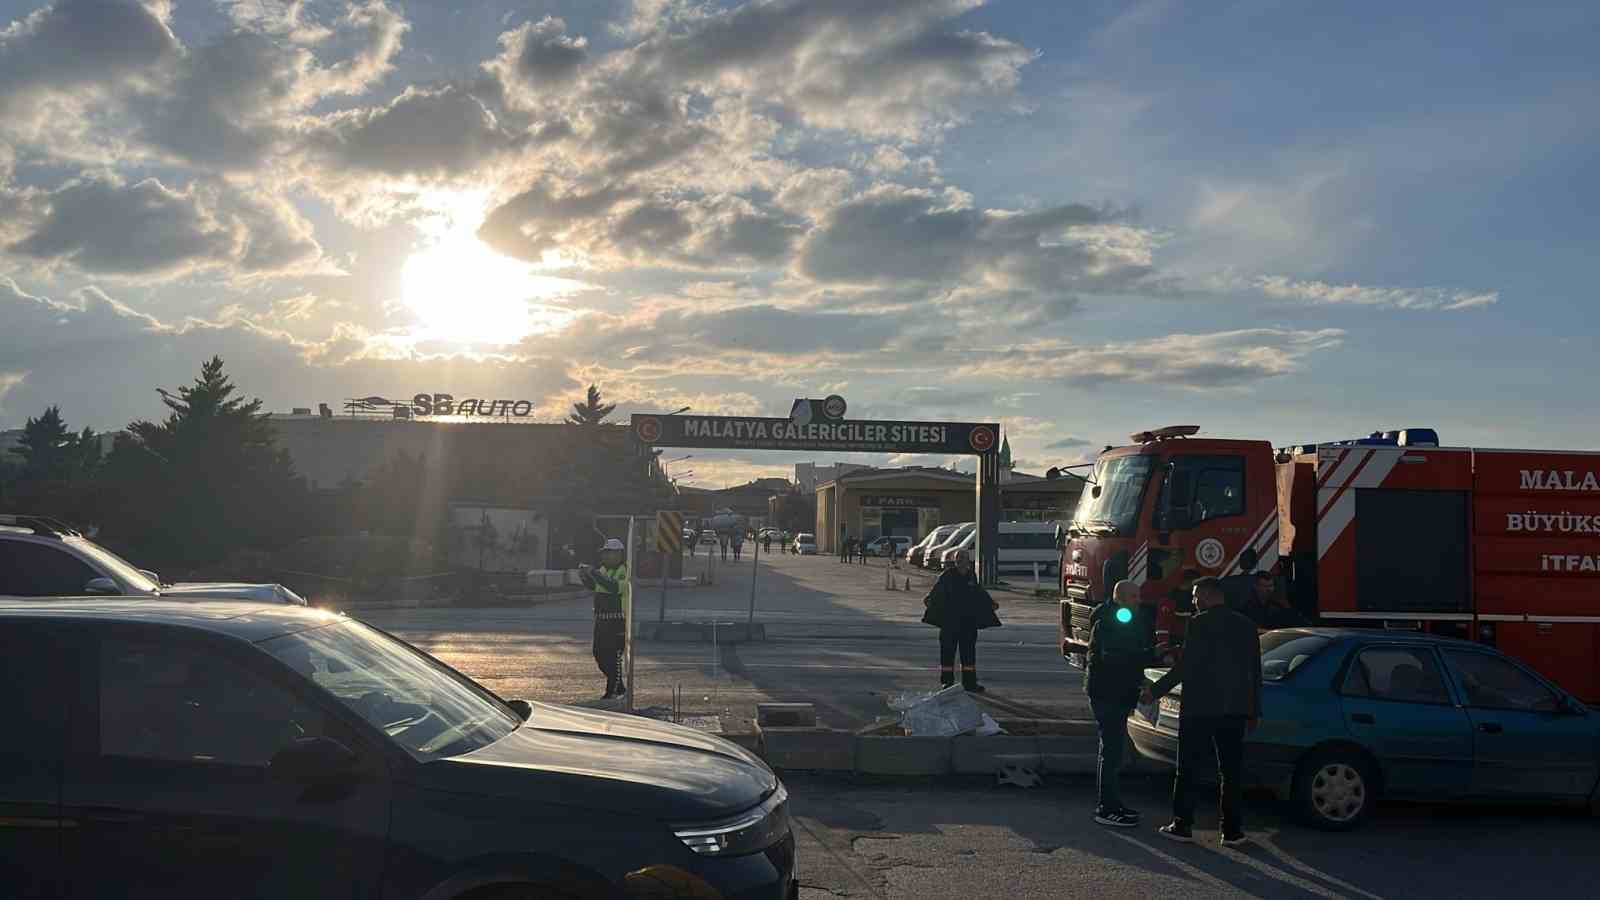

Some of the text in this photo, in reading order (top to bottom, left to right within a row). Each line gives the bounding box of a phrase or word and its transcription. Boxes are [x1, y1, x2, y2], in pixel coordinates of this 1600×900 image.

[413, 394, 532, 417] SB AUTO
[684, 419, 947, 443] MALATYA GALERİCİLER SİTESİ
[1520, 470, 1600, 491] MALA
